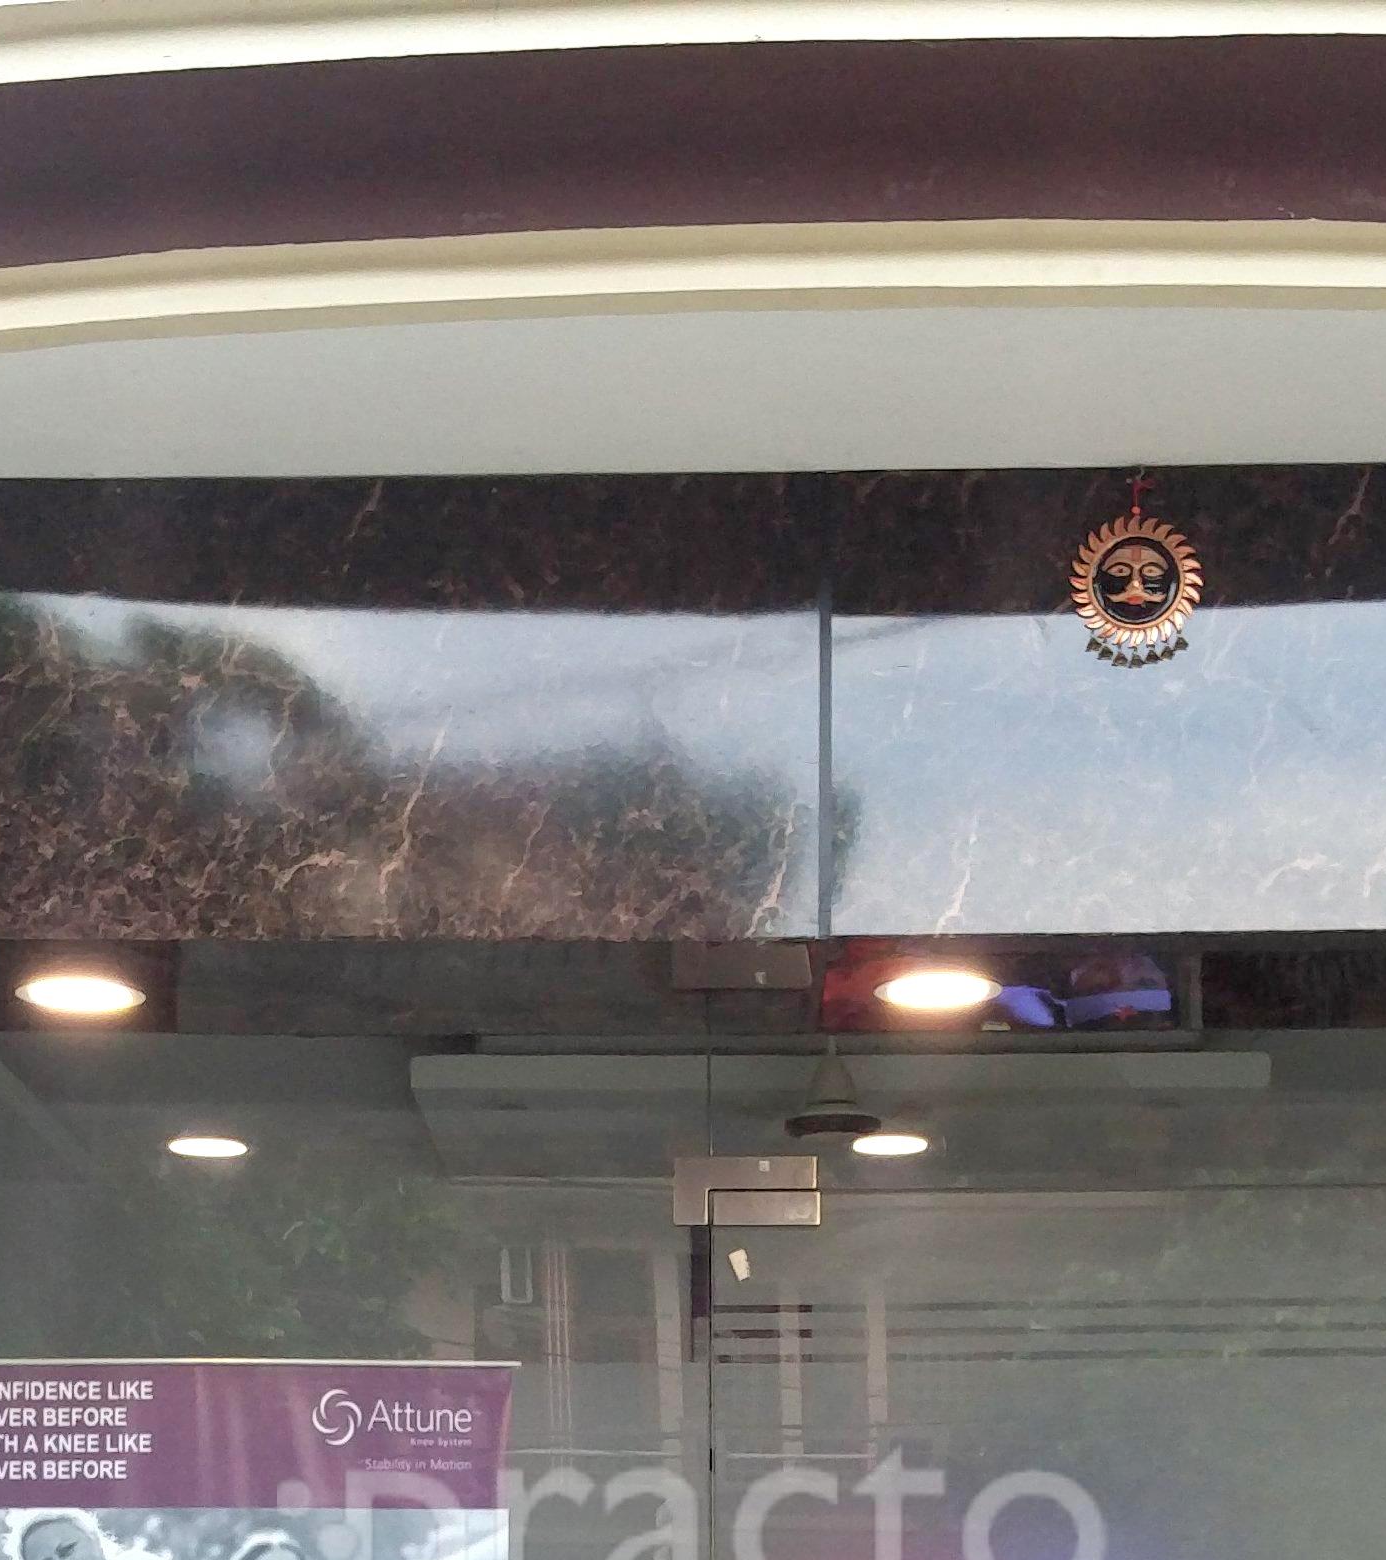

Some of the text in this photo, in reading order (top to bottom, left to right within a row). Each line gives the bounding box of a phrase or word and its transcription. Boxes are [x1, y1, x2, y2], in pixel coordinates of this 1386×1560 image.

[108, 1381, 154, 1400] LIKE
[43, 1407, 128, 1426] BEFORE
[367, 1399, 472, 1432] Attune
[23, 1434, 38, 1453] A
[44, 1433, 99, 1453] KNEE
[106, 1433, 152, 1453] LIKE
[43, 1460, 128, 1480] BEFORE
